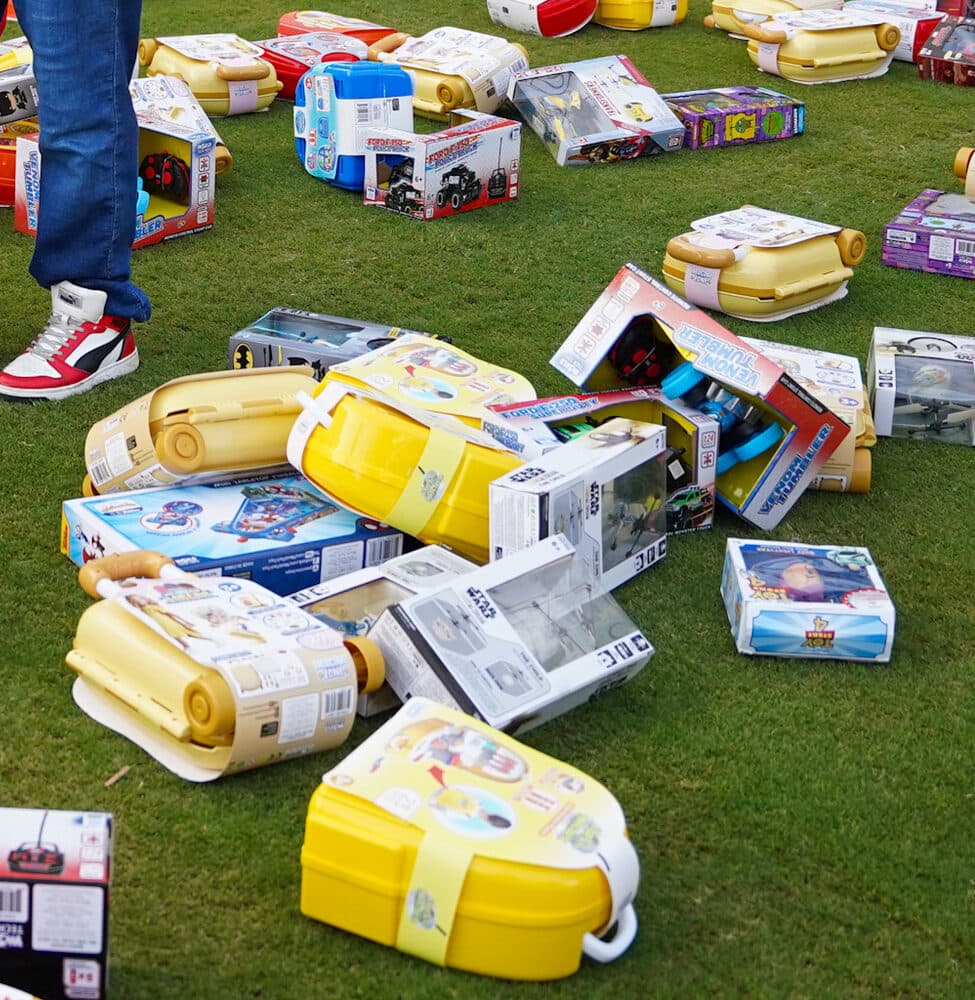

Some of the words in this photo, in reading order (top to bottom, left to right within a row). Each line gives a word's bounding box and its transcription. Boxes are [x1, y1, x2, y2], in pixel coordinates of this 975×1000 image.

[428, 147, 447, 164] FORD
[679, 326, 757, 368] TUMBLER
[697, 353, 760, 387] VENOM
[776, 423, 834, 506] TUMBLER
[758, 454, 803, 514] VENOM
[751, 590, 789, 601] TOY
[813, 616, 829, 632] 4
[801, 638, 835, 649] TOY
